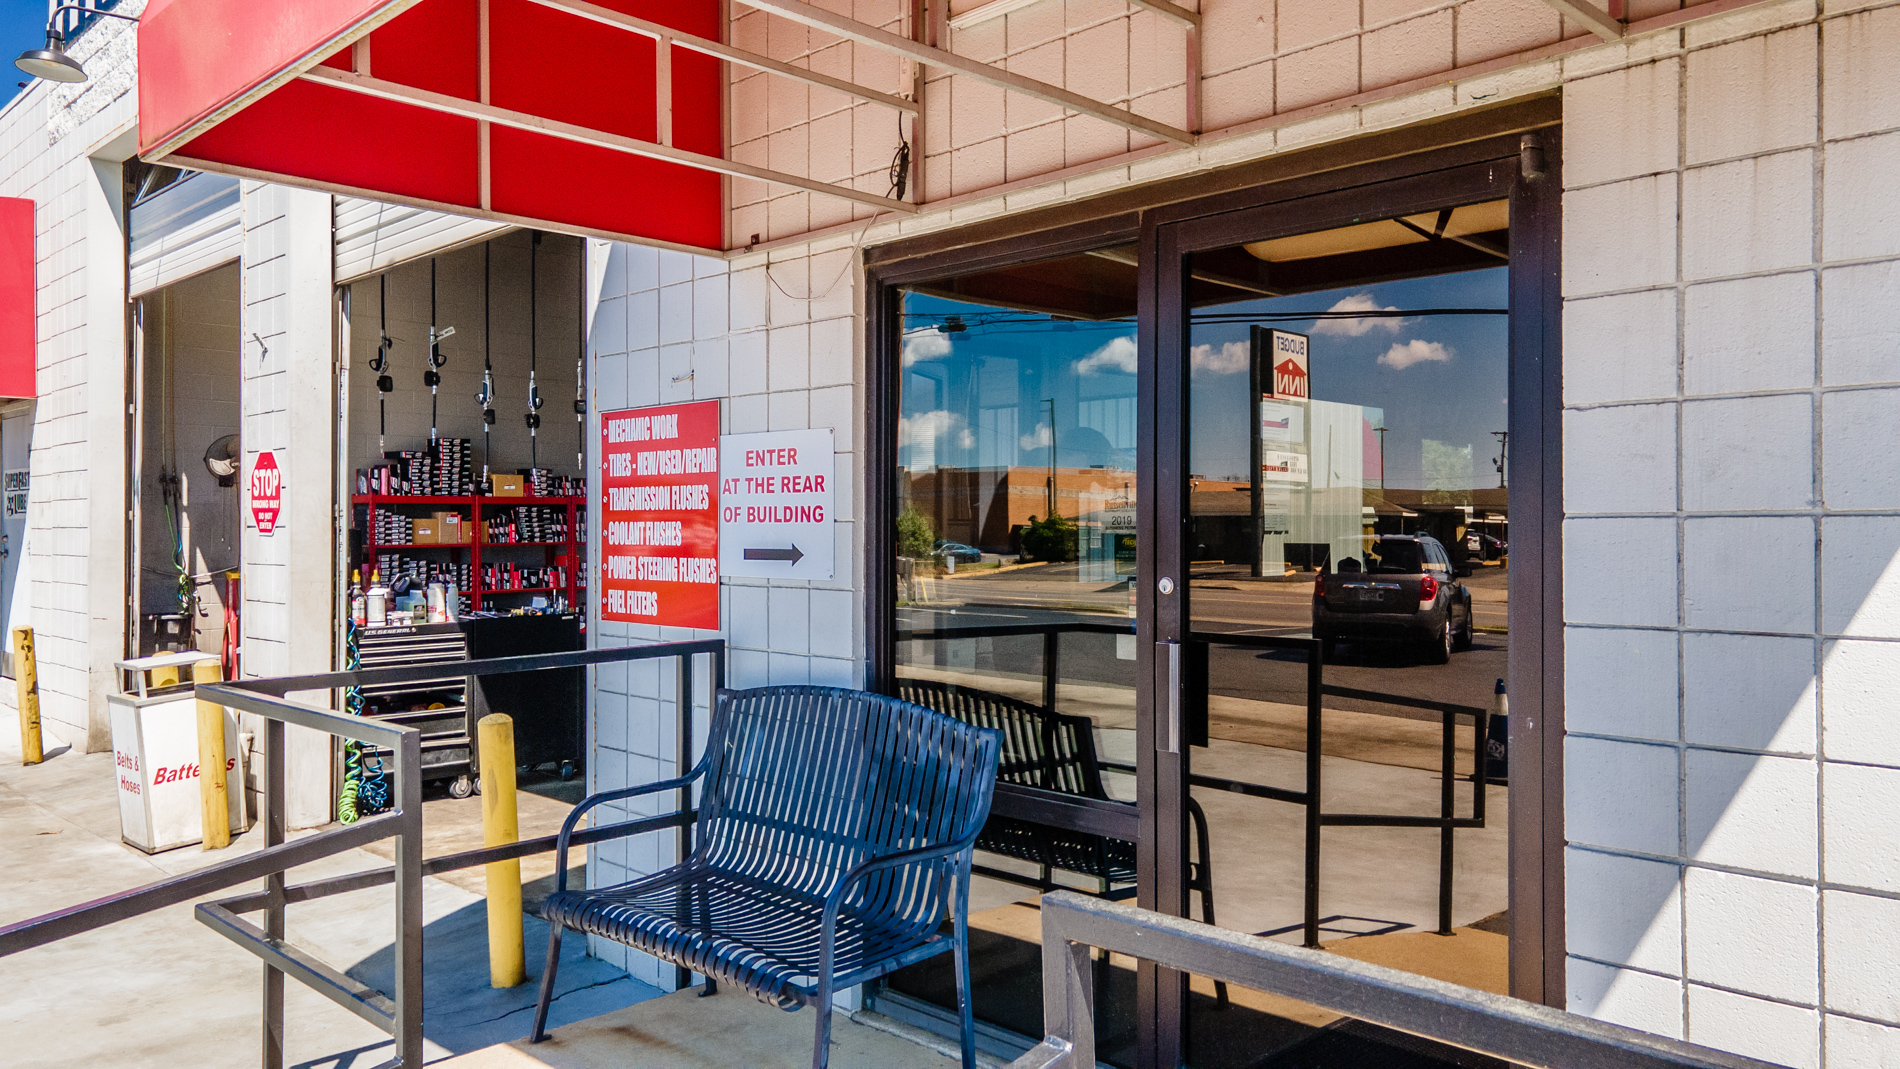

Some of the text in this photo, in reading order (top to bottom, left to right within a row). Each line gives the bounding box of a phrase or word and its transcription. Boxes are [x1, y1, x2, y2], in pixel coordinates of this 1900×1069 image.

[608, 414, 678, 443] MECHANIC WORK
[608, 453, 631, 477] TIRES
[637, 447, 717, 476] NEW/USED/REPAIR
[746, 448, 798, 467] ENTER
[253, 468, 279, 497] STOP
[722, 475, 825, 495] AT THE REAR
[252, 499, 279, 508] WRONG WAY
[608, 484, 709, 511] TRANSMISSION FLUSHES
[258, 512, 273, 520] DO NOT
[723, 505, 824, 523] OF BUILDING
[1111, 515, 1132, 525] 2019
[608, 521, 682, 546] COOLANT FLUSHES
[608, 555, 717, 584] POWER STEERING FLUSHES
[607, 589, 658, 616] FUEL FILTERS
[116, 750, 140, 772] Belts &
[153, 757, 236, 786] Battes
[120, 774, 141, 795] Hoses
